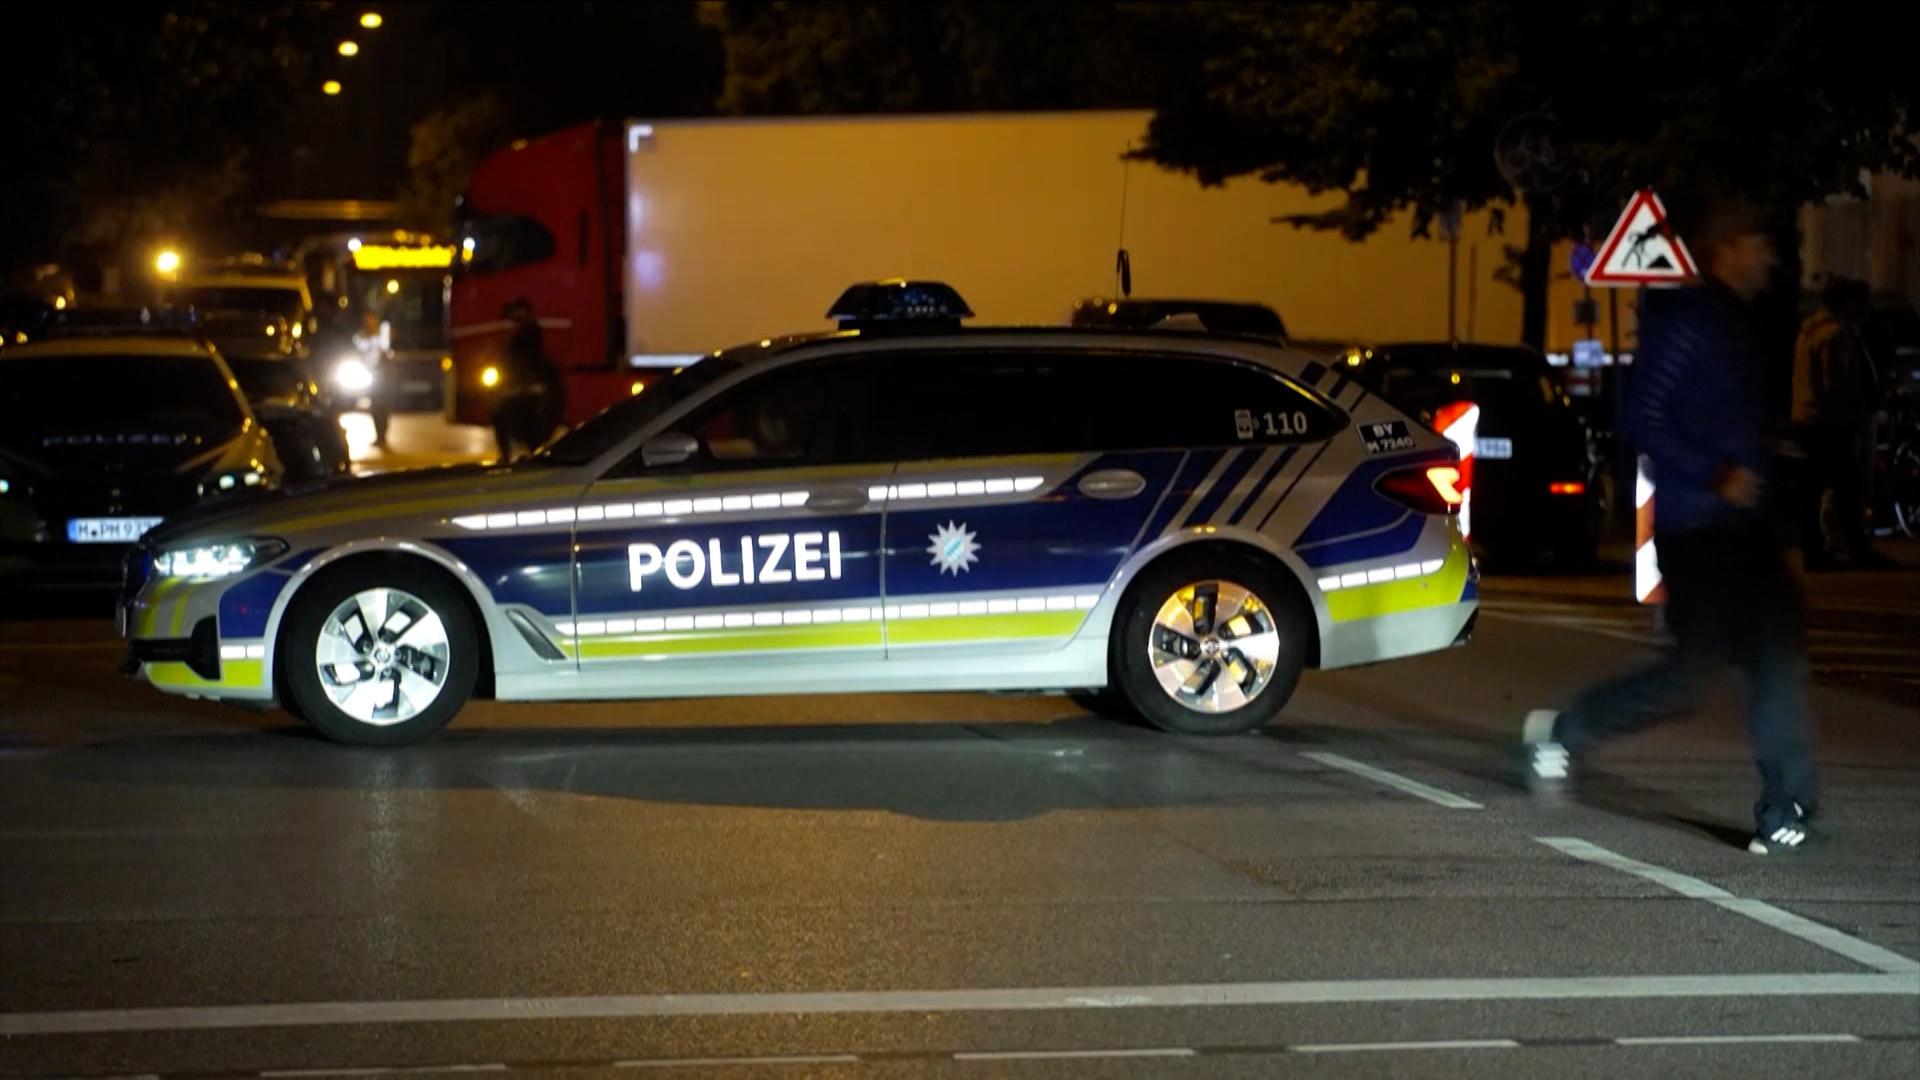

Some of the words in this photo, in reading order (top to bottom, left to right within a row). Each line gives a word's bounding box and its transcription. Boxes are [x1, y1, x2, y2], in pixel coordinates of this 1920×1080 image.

[1263, 411, 1308, 435] 110
[1372, 423, 1392, 438] BY
[627, 530, 843, 592] POLIZEI
